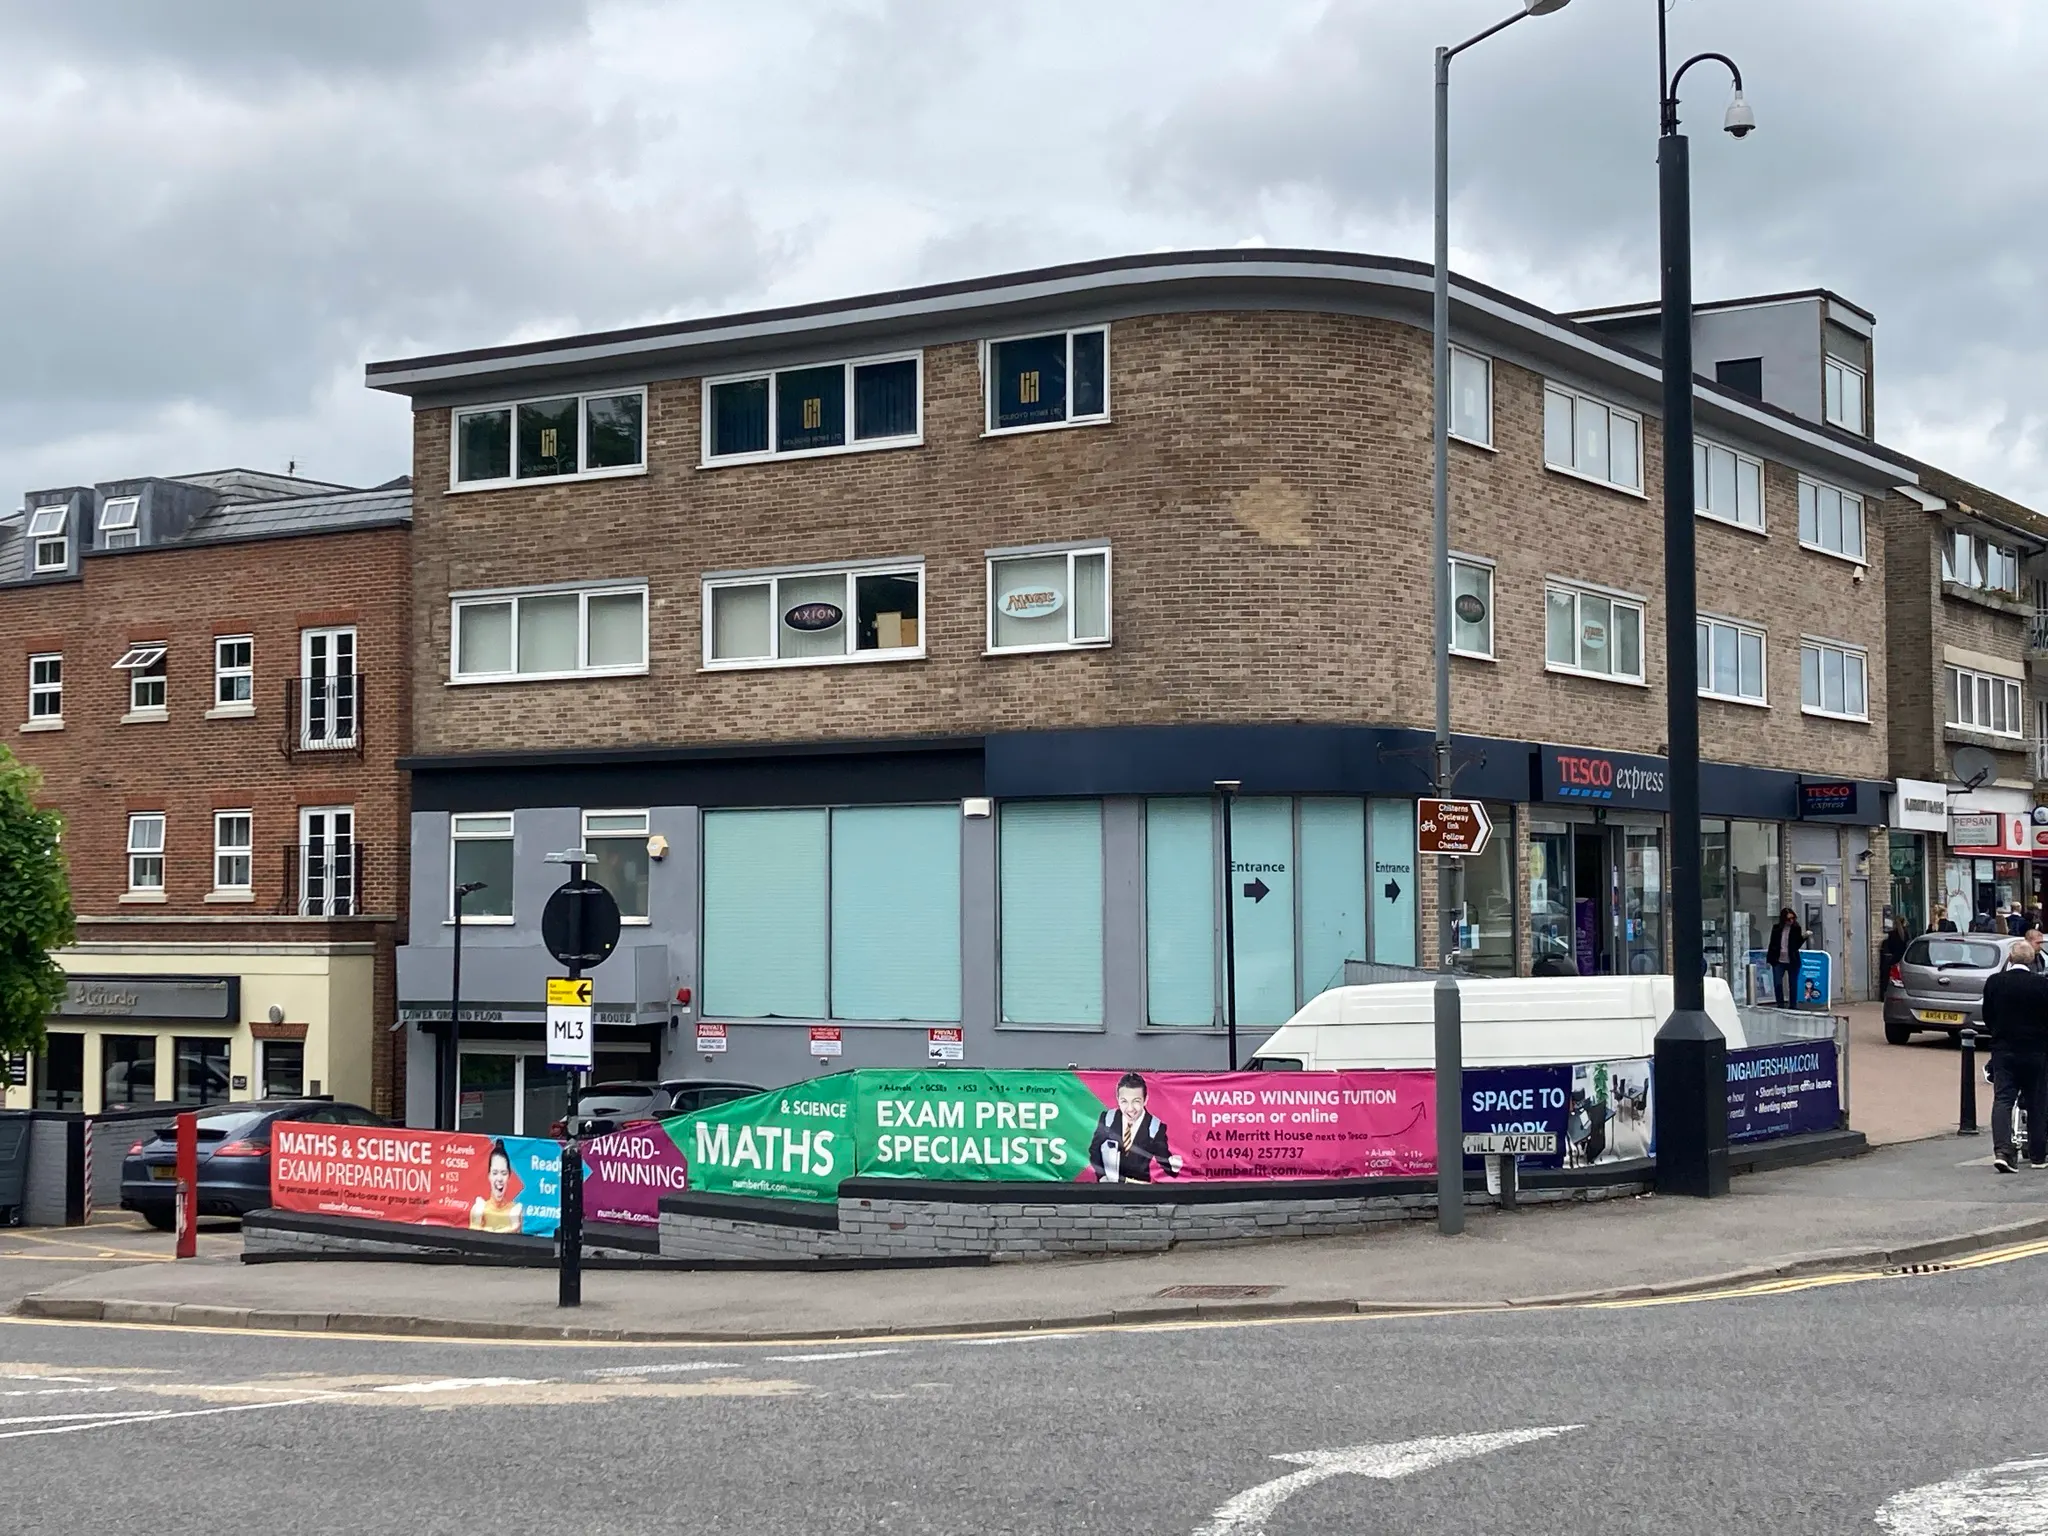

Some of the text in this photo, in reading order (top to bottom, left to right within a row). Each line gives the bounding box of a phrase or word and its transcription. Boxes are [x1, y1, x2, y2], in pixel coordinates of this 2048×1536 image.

[793, 609, 835, 620] AXION
[1557, 756, 1664, 798] TESCO express
[1806, 786, 1850, 797] TESCO
[1811, 801, 1845, 811] express
[1437, 812, 1469, 823] Cycleway
[1953, 817, 1992, 827] PEPSAN
[1442, 832, 1465, 841] Follow
[1437, 840, 1469, 850] Chesham
[1231, 861, 1286, 873] Entrance
[1375, 861, 1411, 874] Entrance
[402, 1009, 503, 1022] LOWER GROND FLOOR
[600, 1012, 632, 1024] HOUSE
[554, 1020, 584, 1040] ML3
[963, 1085, 978, 1093] KS3
[1026, 1085, 1057, 1096] Primary
[1192, 1089, 1397, 1106] AWARD WINNING TUITION
[1472, 1087, 1565, 1112] SPACE TO
[781, 1099, 847, 1118] & SCIENCE
[1781, 1100, 1798, 1110] rooms
[877, 1100, 1059, 1130] EXAM PREP
[1192, 1108, 1339, 1127] In person or online
[1206, 1130, 1221, 1141] At
[1225, 1129, 1270, 1141] Merritt
[1274, 1129, 1313, 1141] House
[1338, 1132, 1347, 1140] to
[279, 1132, 432, 1165] MATHS & SCIENCE
[445, 1144, 475, 1155] A-Levels
[589, 1136, 660, 1160] AWARD-
[696, 1121, 835, 1177] MATHS
[877, 1134, 1068, 1165] SPECIALISTS
[1503, 1136, 1554, 1152] AVENUE
[1206, 1147, 1304, 1160] (01494) 257737
[445, 1157, 469, 1169] GCSEs
[278, 1158, 432, 1192] EXAM PREPARATION
[600, 1161, 685, 1189] WINNING
[539, 1178, 558, 1194] for
[444, 1197, 469, 1210] Primary
[526, 1204, 561, 1219] exams
